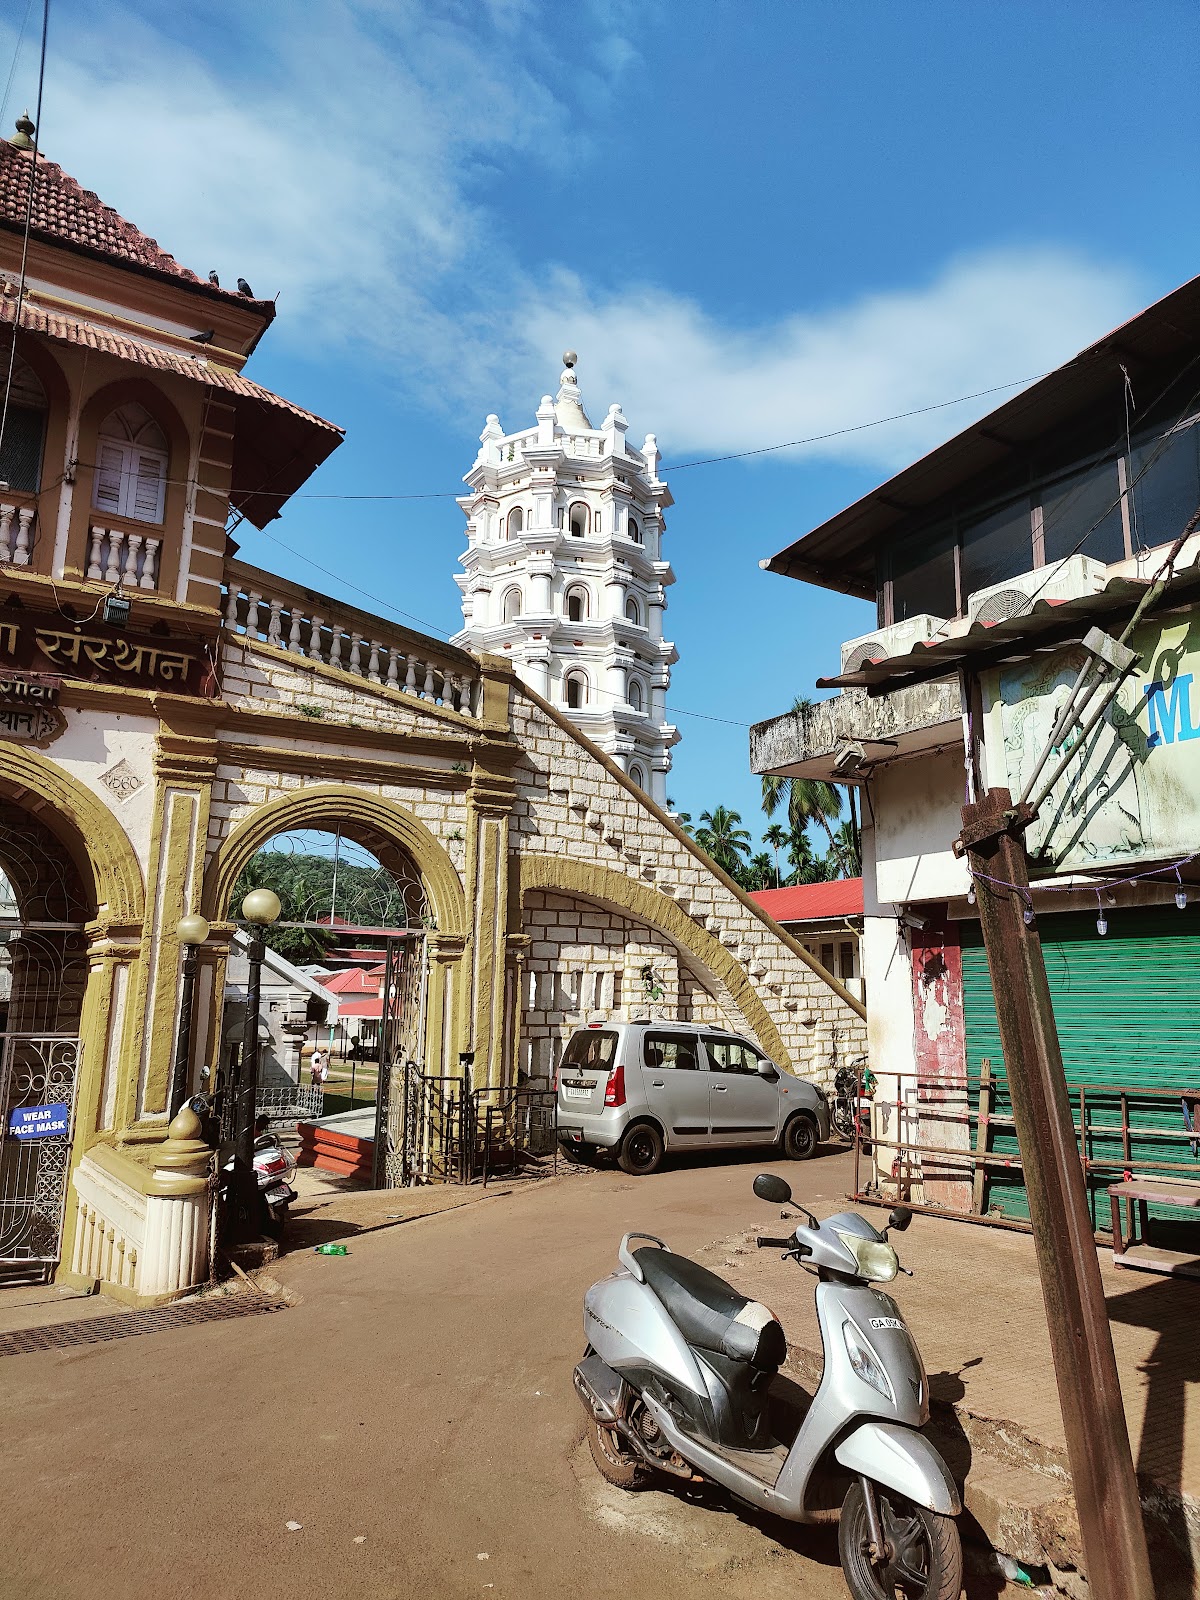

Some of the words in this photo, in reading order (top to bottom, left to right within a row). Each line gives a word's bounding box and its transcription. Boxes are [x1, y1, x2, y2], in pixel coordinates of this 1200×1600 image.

[34, 626, 197, 681] संस्थान
[22, 1110, 52, 1122] WEAR
[9, 1124, 35, 1136] FACE
[36, 1120, 66, 1132] MASK
[871, 1319, 886, 1328] GA
